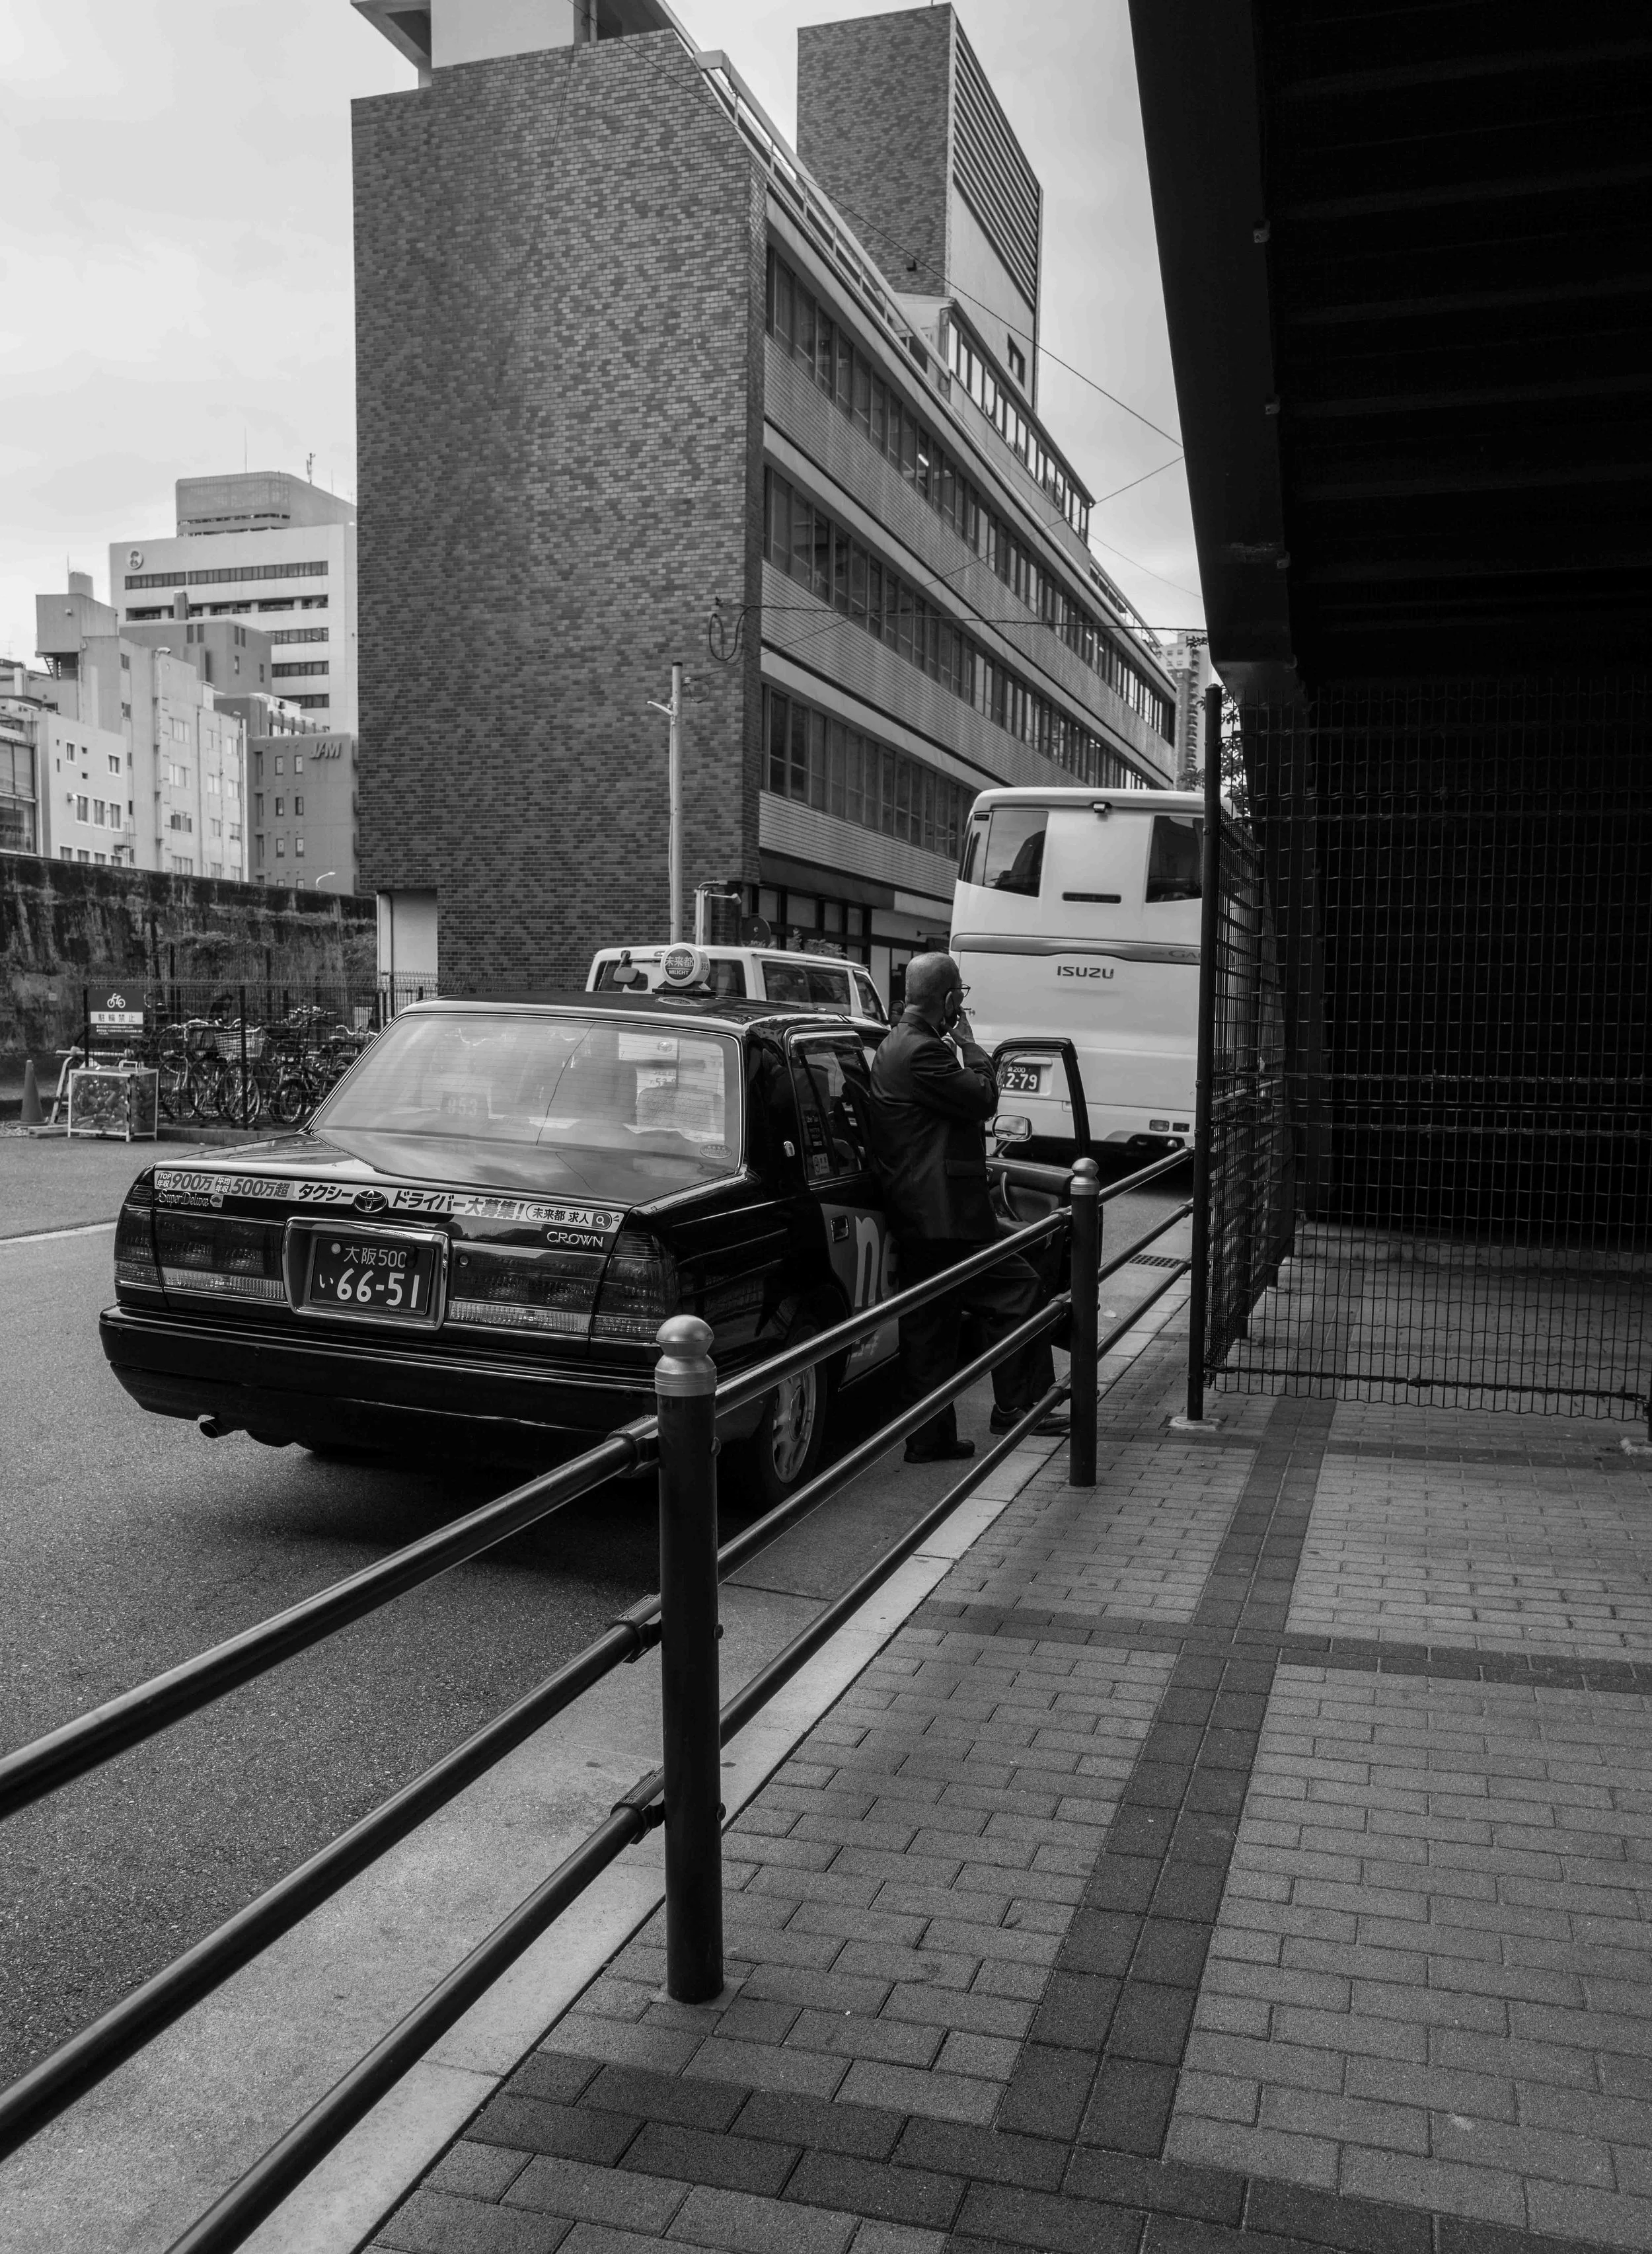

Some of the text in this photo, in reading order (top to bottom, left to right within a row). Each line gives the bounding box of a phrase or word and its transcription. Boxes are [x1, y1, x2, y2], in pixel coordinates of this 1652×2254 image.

[309, 741, 342, 759] JAM
[1168, 951, 1201, 959] GA
[665, 956, 695, 967] 未来都
[1057, 966, 1114, 979] ISUZU
[98, 1013, 136, 1023] 駐輪禁止
[157, 1179, 170, 1188] 年収
[217, 1177, 231, 1185] 平均
[172, 1173, 215, 1190] 900万
[231, 1177, 291, 1198] 500万超
[299, 1183, 354, 1202] タクシー
[216, 1183, 229, 1193] 年収
[157, 1189, 210, 1208] Super Deluxe
[533, 1207, 590, 1225] 未来都 求人
[546, 1231, 604, 1248] CROWN
